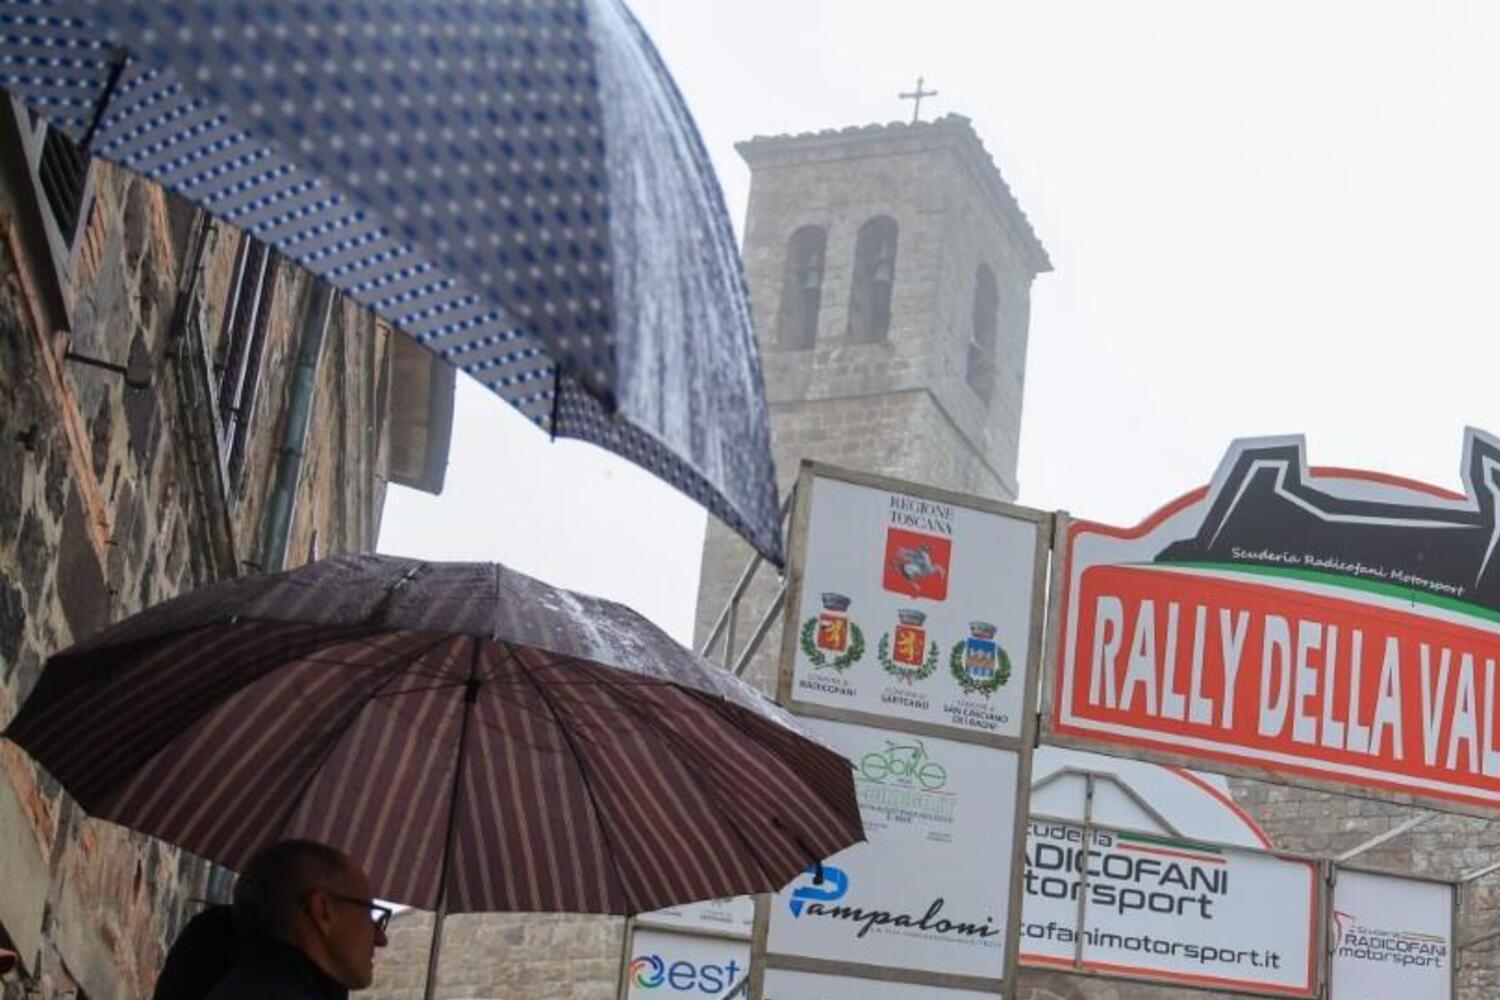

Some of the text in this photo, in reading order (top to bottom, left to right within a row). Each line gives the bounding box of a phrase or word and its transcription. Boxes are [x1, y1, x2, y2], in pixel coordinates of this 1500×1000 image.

[890, 495, 954, 521] REGIONE
[890, 510, 952, 535] TOSCANA
[1088, 595, 1250, 729] RALLY
[1258, 614, 1405, 760] DELLA
[1025, 842, 1229, 895] DICOFANI
[789, 864, 1000, 938] Pampaloni
[1338, 945, 1443, 969] motorsport
[1344, 932, 1446, 957] RADICOFANI
